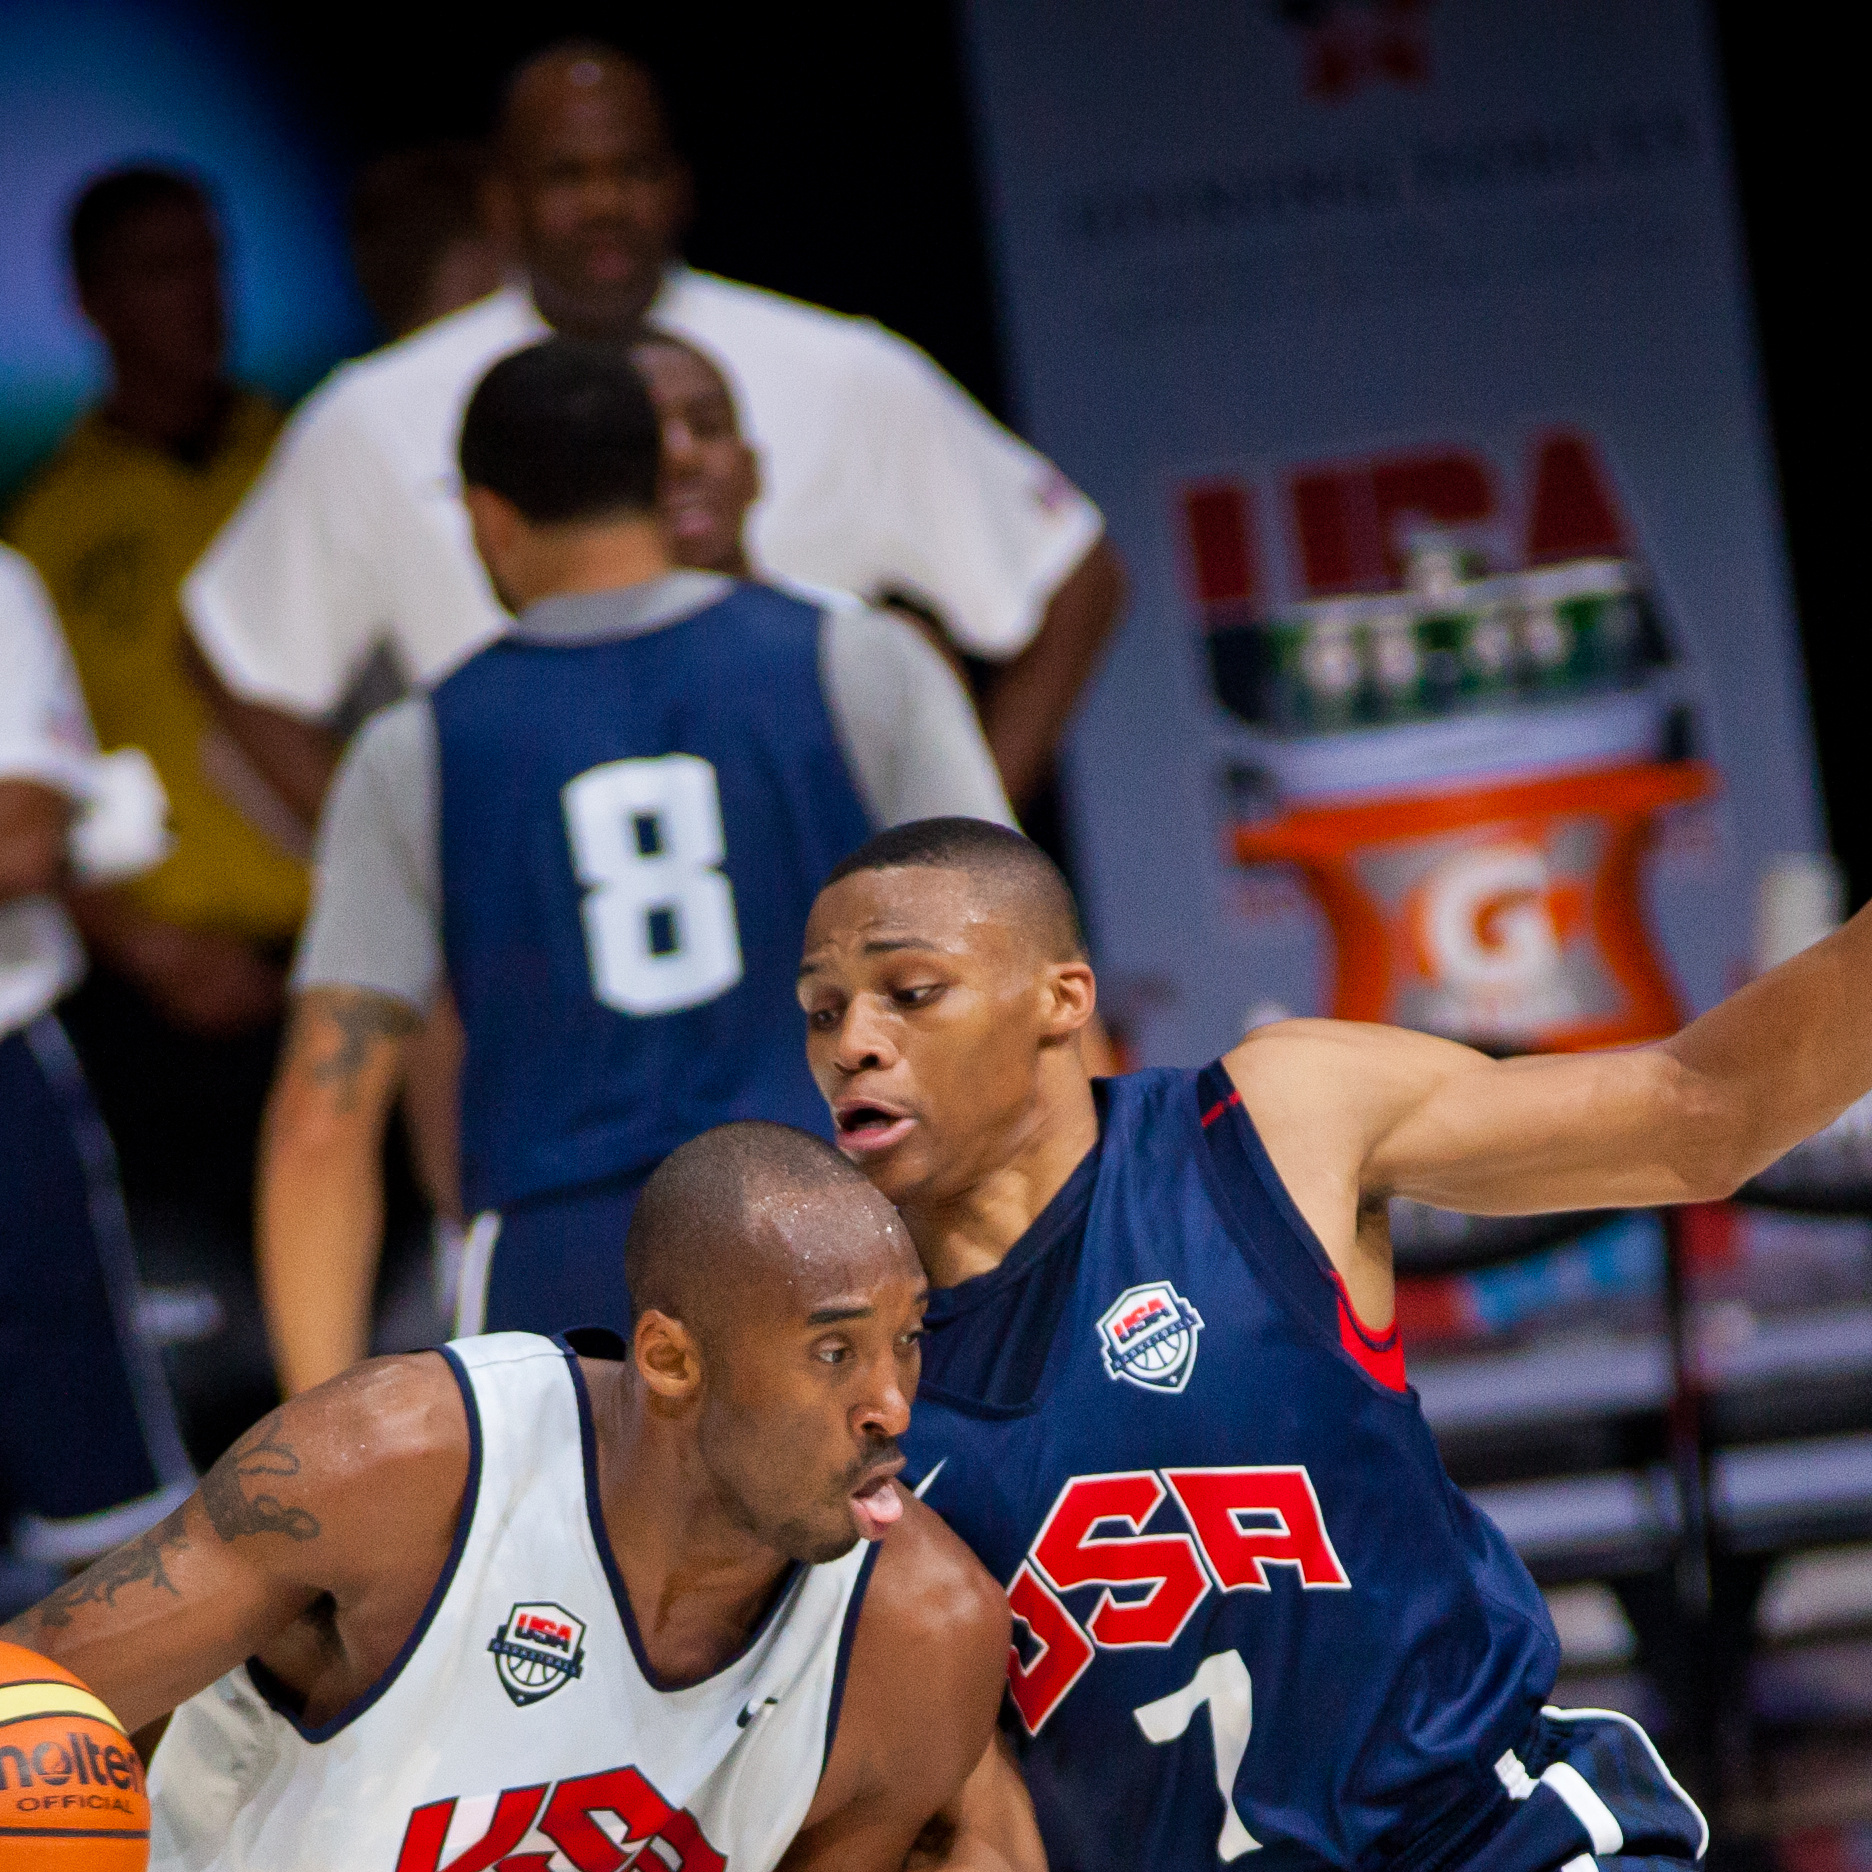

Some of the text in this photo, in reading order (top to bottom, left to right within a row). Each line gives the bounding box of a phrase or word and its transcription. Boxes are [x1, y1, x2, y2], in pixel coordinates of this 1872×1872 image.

[560, 752, 744, 1017] 8
[1112, 1298, 1172, 1344] USA
[514, 1612, 572, 1654] USA
[1133, 1648, 1264, 1863] 7
